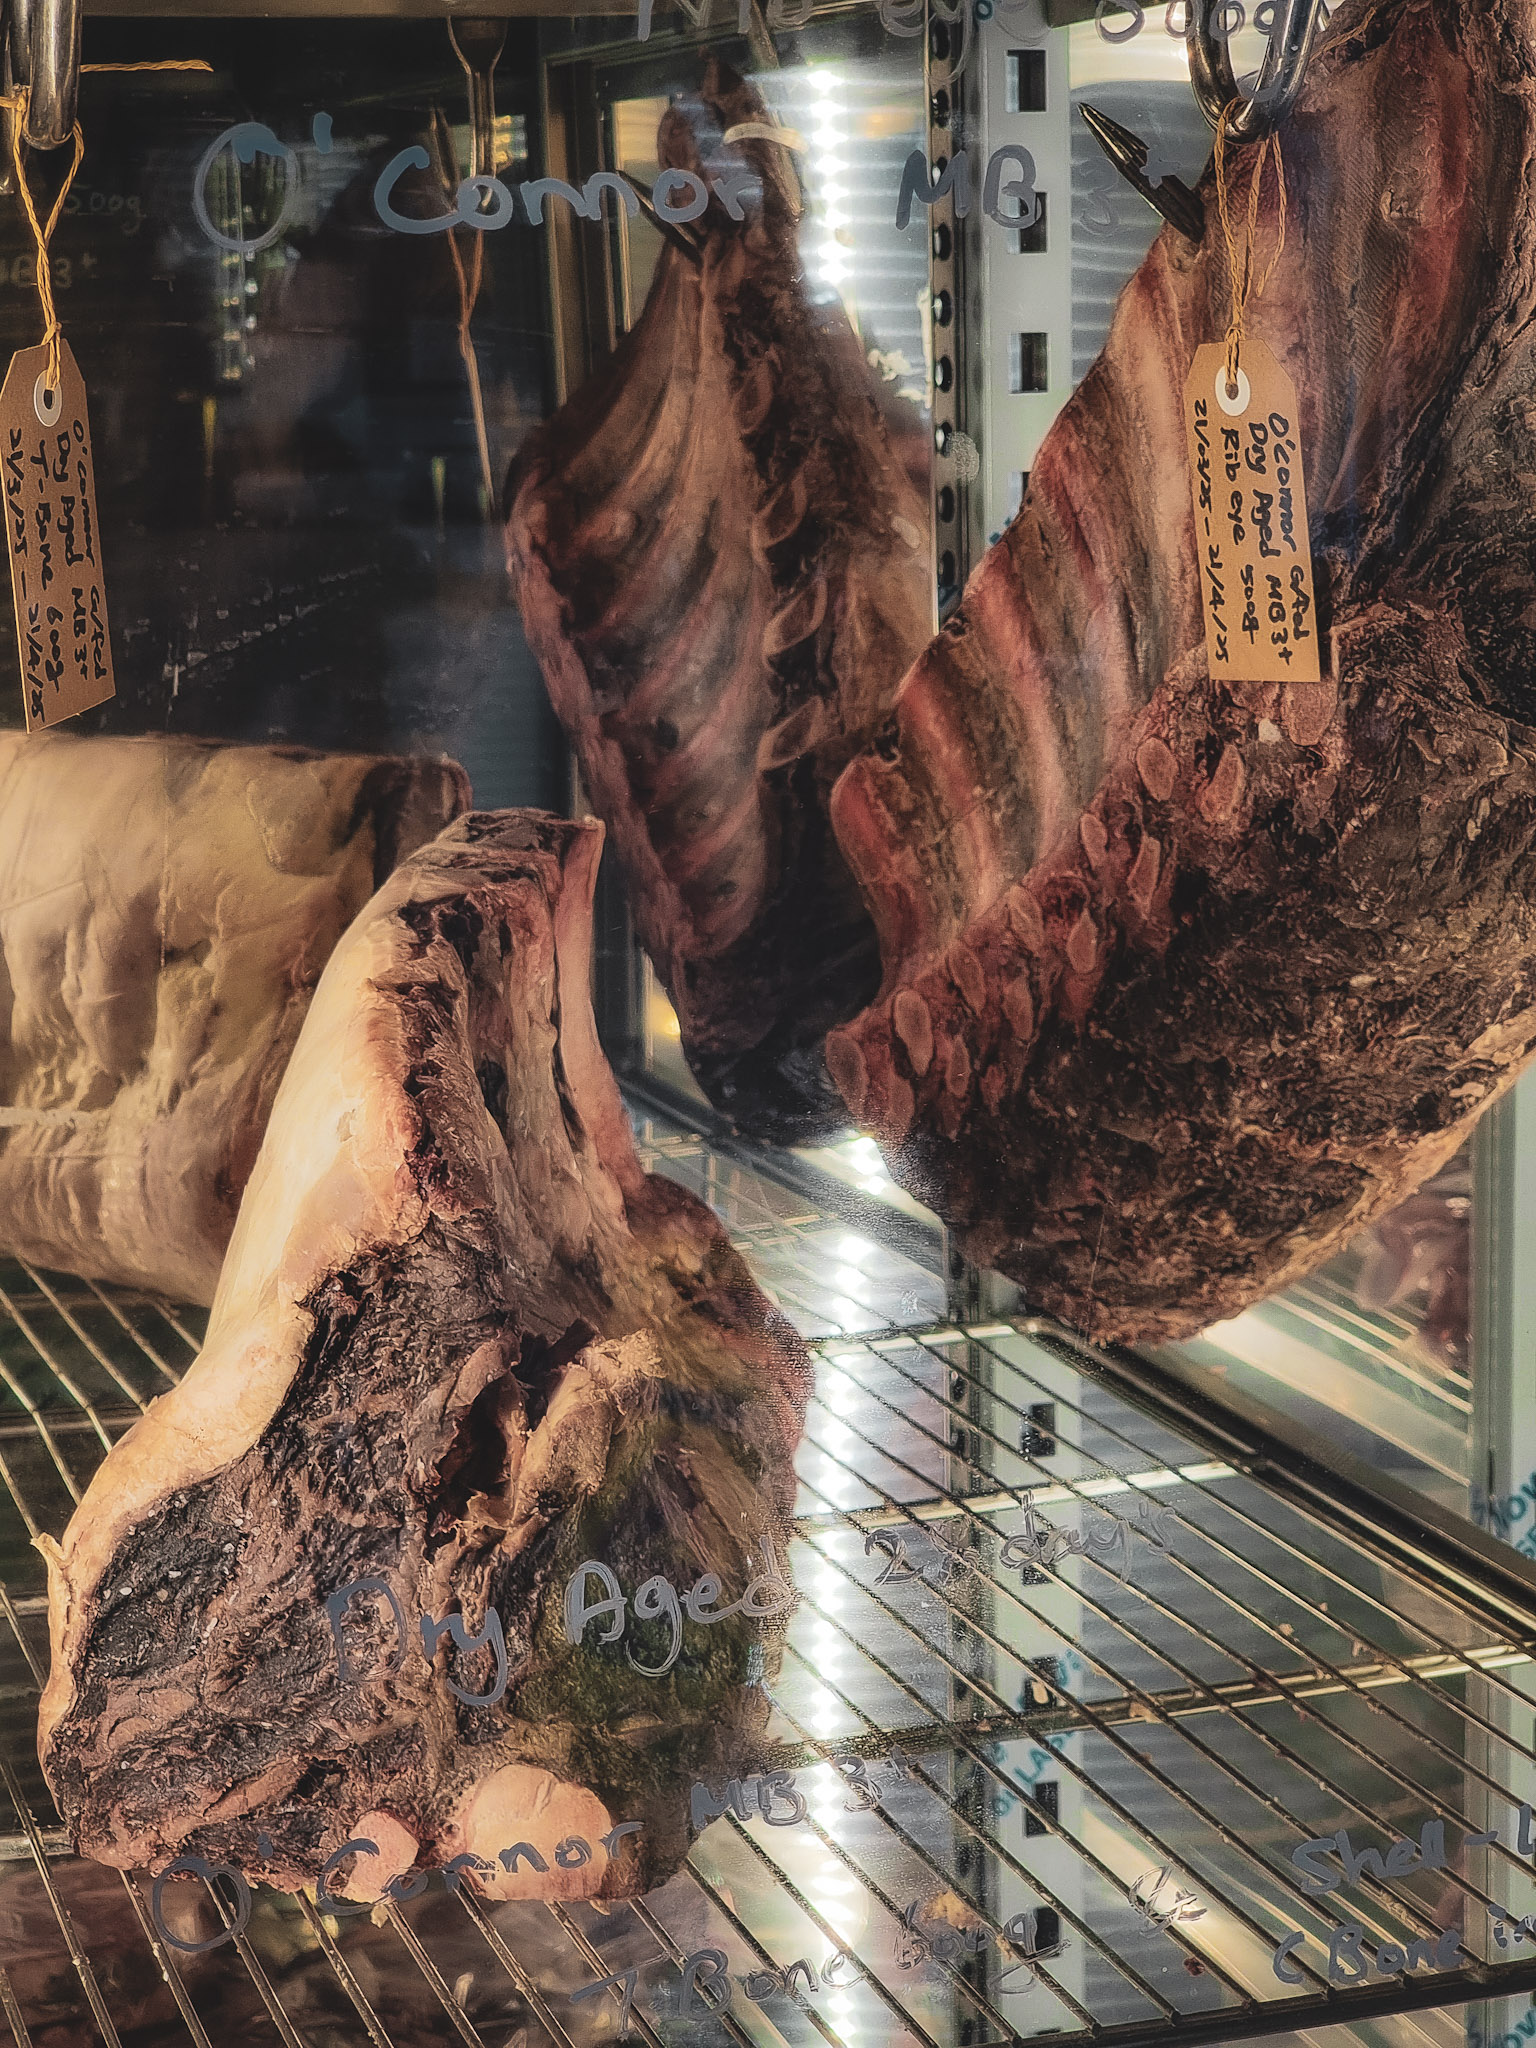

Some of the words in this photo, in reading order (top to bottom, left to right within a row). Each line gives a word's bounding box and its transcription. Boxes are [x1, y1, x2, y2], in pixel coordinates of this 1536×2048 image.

[1221, 427, 1239, 482] Rib
[1245, 422, 1268, 475] Dry
[57, 495, 84, 568] Aged
[1228, 490, 1246, 546] eye
[1251, 488, 1281, 559] Aged
[1240, 564, 1261, 645] 500g
[44, 605, 65, 694] 600g
[329, 1578, 507, 1705] Dry
[564, 1535, 800, 1677] Aged
[1292, 1819, 1448, 1896] Shell
